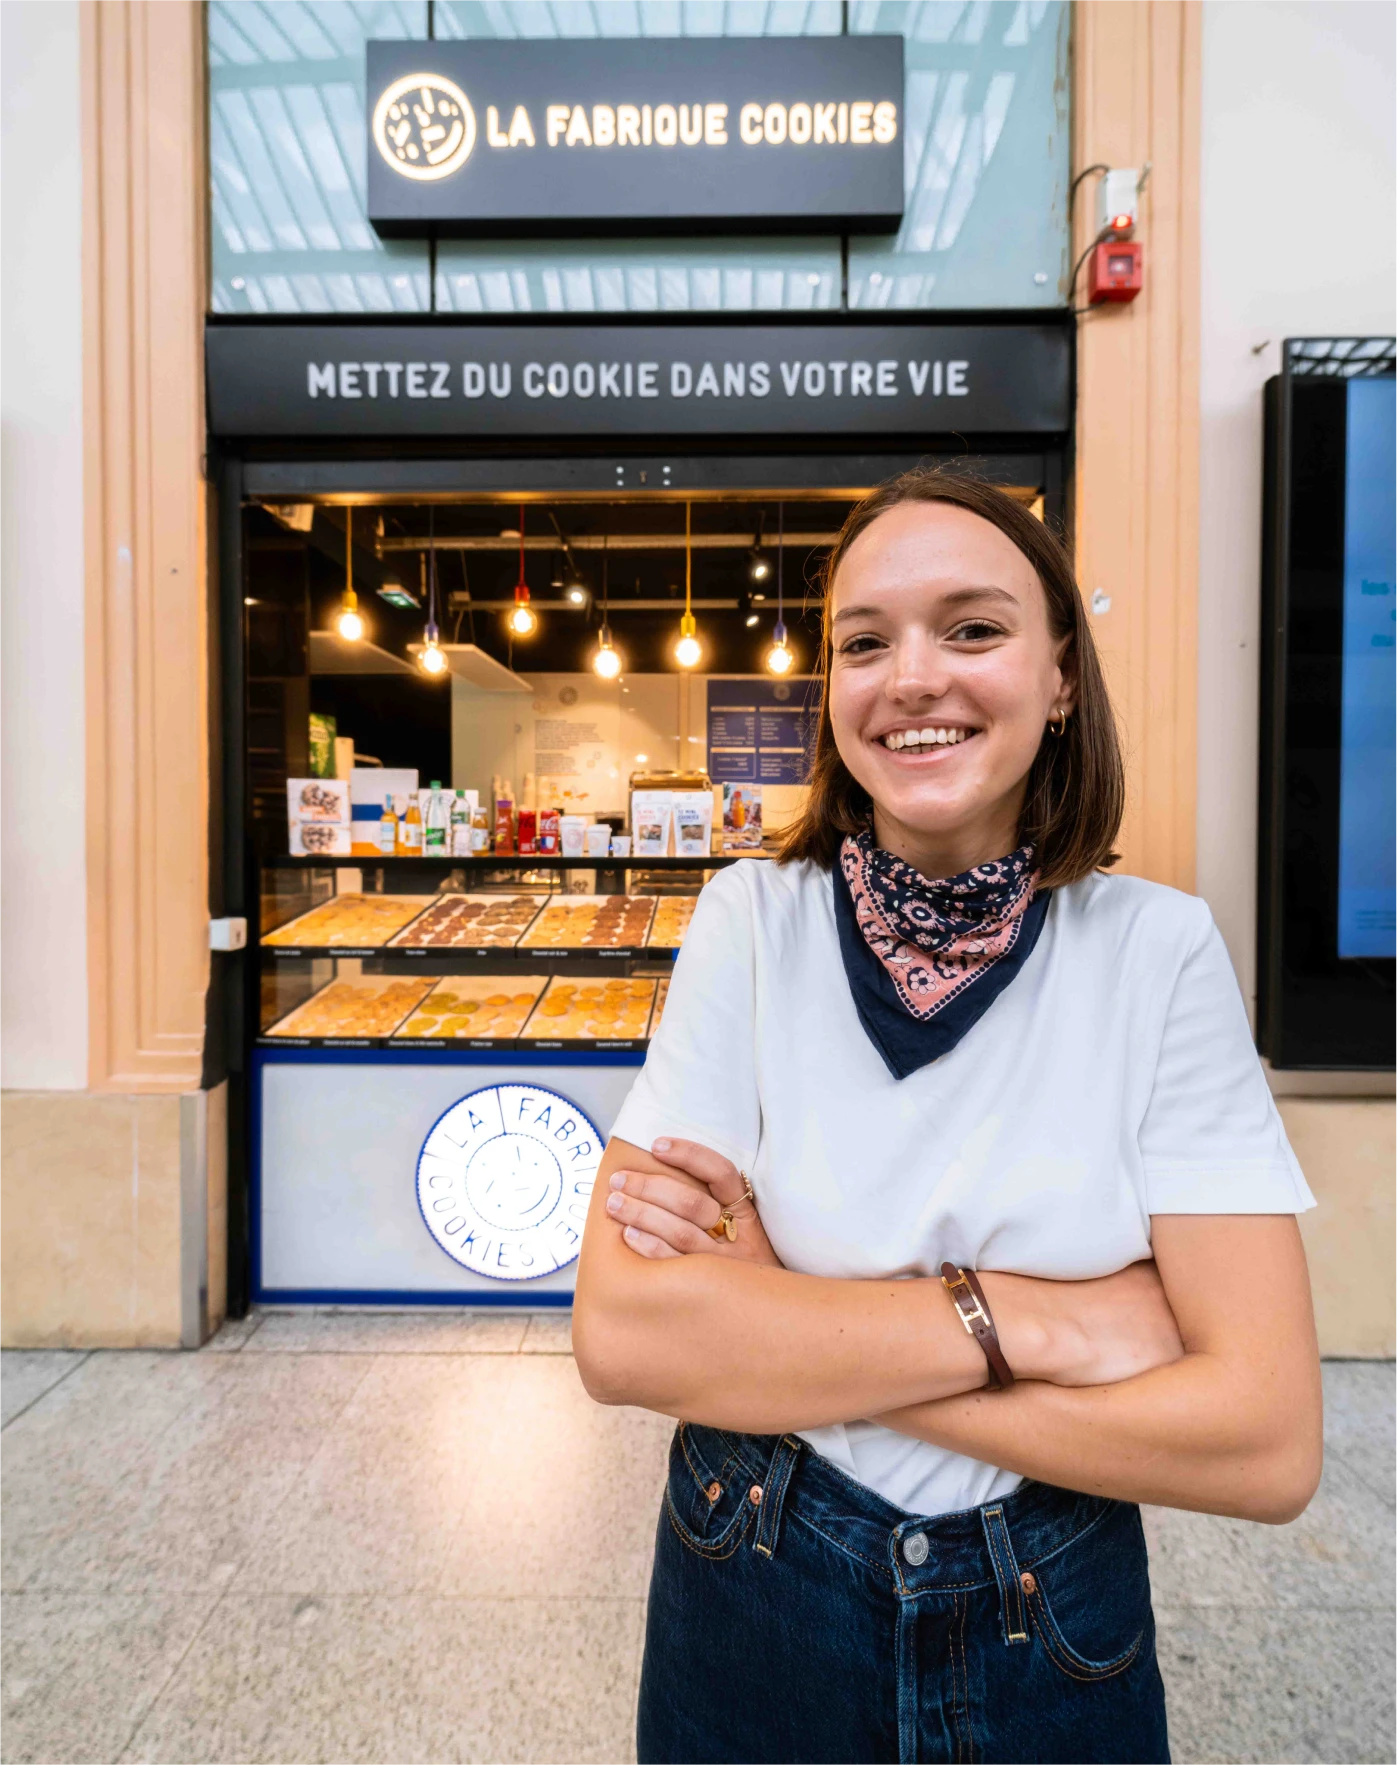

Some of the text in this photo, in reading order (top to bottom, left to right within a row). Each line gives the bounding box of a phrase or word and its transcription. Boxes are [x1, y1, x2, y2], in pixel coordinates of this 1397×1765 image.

[486, 101, 898, 148] LA FABRIQUE COOKIES
[308, 361, 969, 398] METTEZ DU COOKIE DANS VOTRE VIE
[443, 1109, 486, 1149] LA
[428, 1174, 535, 1268] COOKIES
